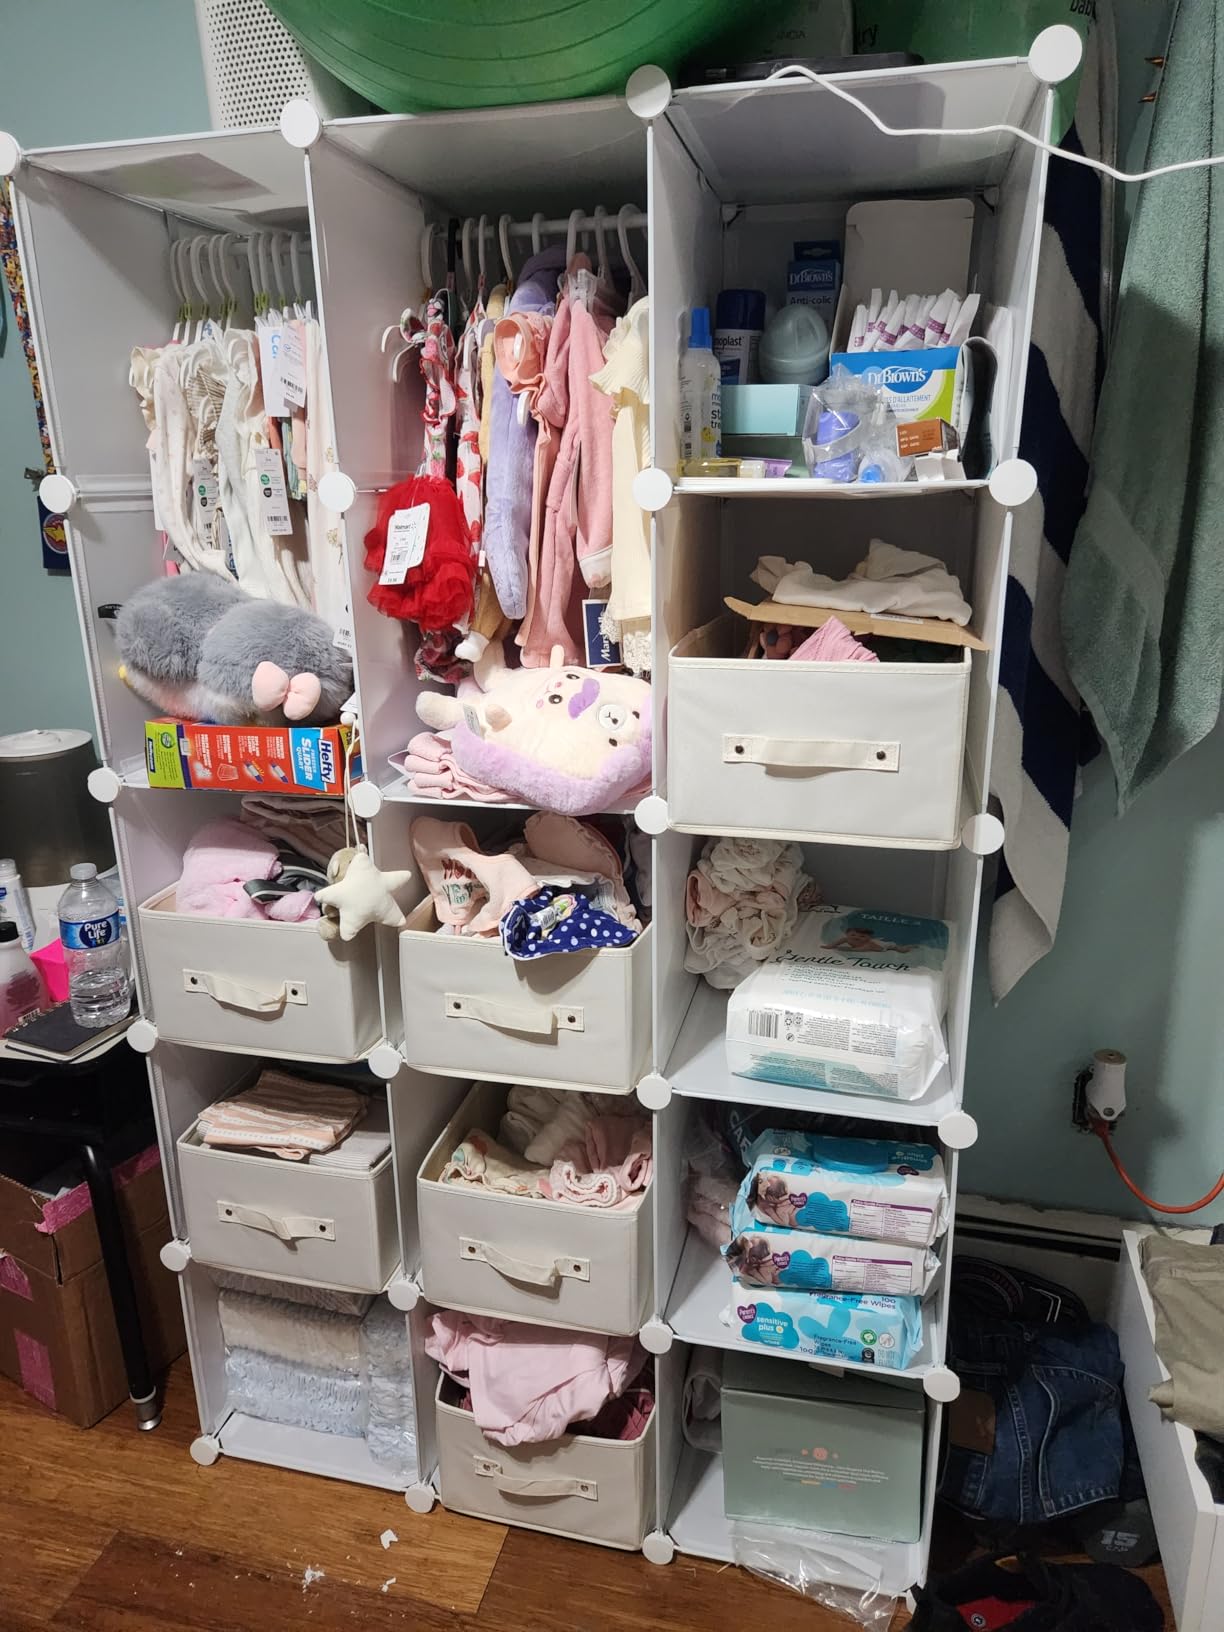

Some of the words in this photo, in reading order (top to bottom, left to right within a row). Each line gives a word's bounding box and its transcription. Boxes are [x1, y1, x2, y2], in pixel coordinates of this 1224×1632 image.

[296, 746, 304, 770] QUART
[301, 737, 313, 781] SLIDER
[320, 742, 334, 782] Hefty
[84, 920, 108, 932] Pure
[88, 929, 106, 940] Life
[770, 949, 846, 966] Gentle
[847, 956, 911, 972] Touch
[870, 1299, 896, 1310] Wipes
[756, 1316, 789, 1327] sensitive
[758, 1323, 774, 1332] plus
